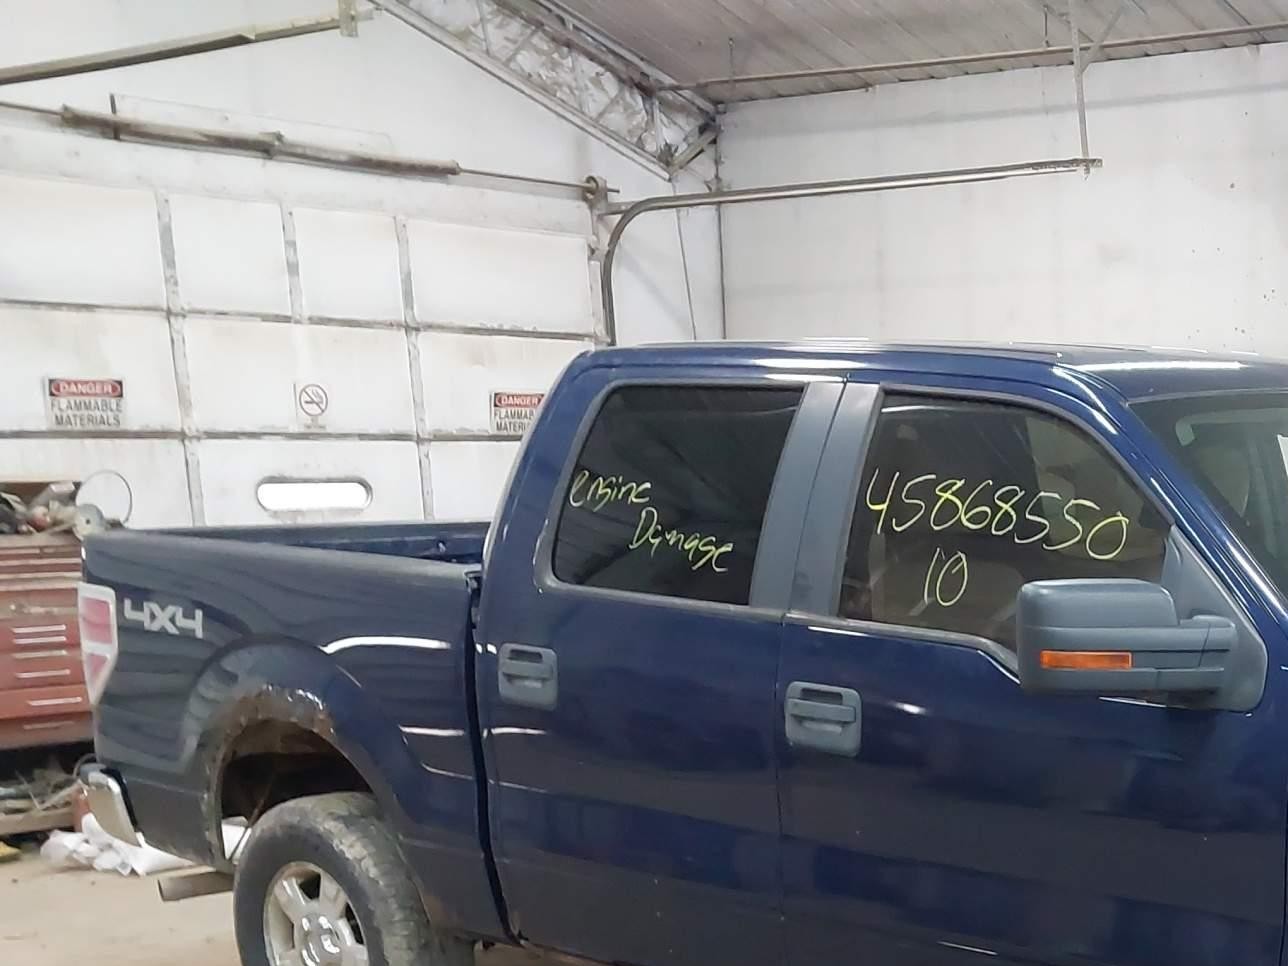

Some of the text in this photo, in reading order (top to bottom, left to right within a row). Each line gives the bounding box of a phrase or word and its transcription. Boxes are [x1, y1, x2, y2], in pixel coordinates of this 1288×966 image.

[59, 382, 113, 394] DANGER
[501, 395, 539, 405] DANGER
[50, 399, 122, 413] FLAMMABLE
[54, 413, 121, 426] MATERIALS
[866, 468, 1129, 560] 45868550
[628, 506, 734, 572] Damage
[924, 547, 968, 606] 10
[123, 597, 203, 639] 4X4
